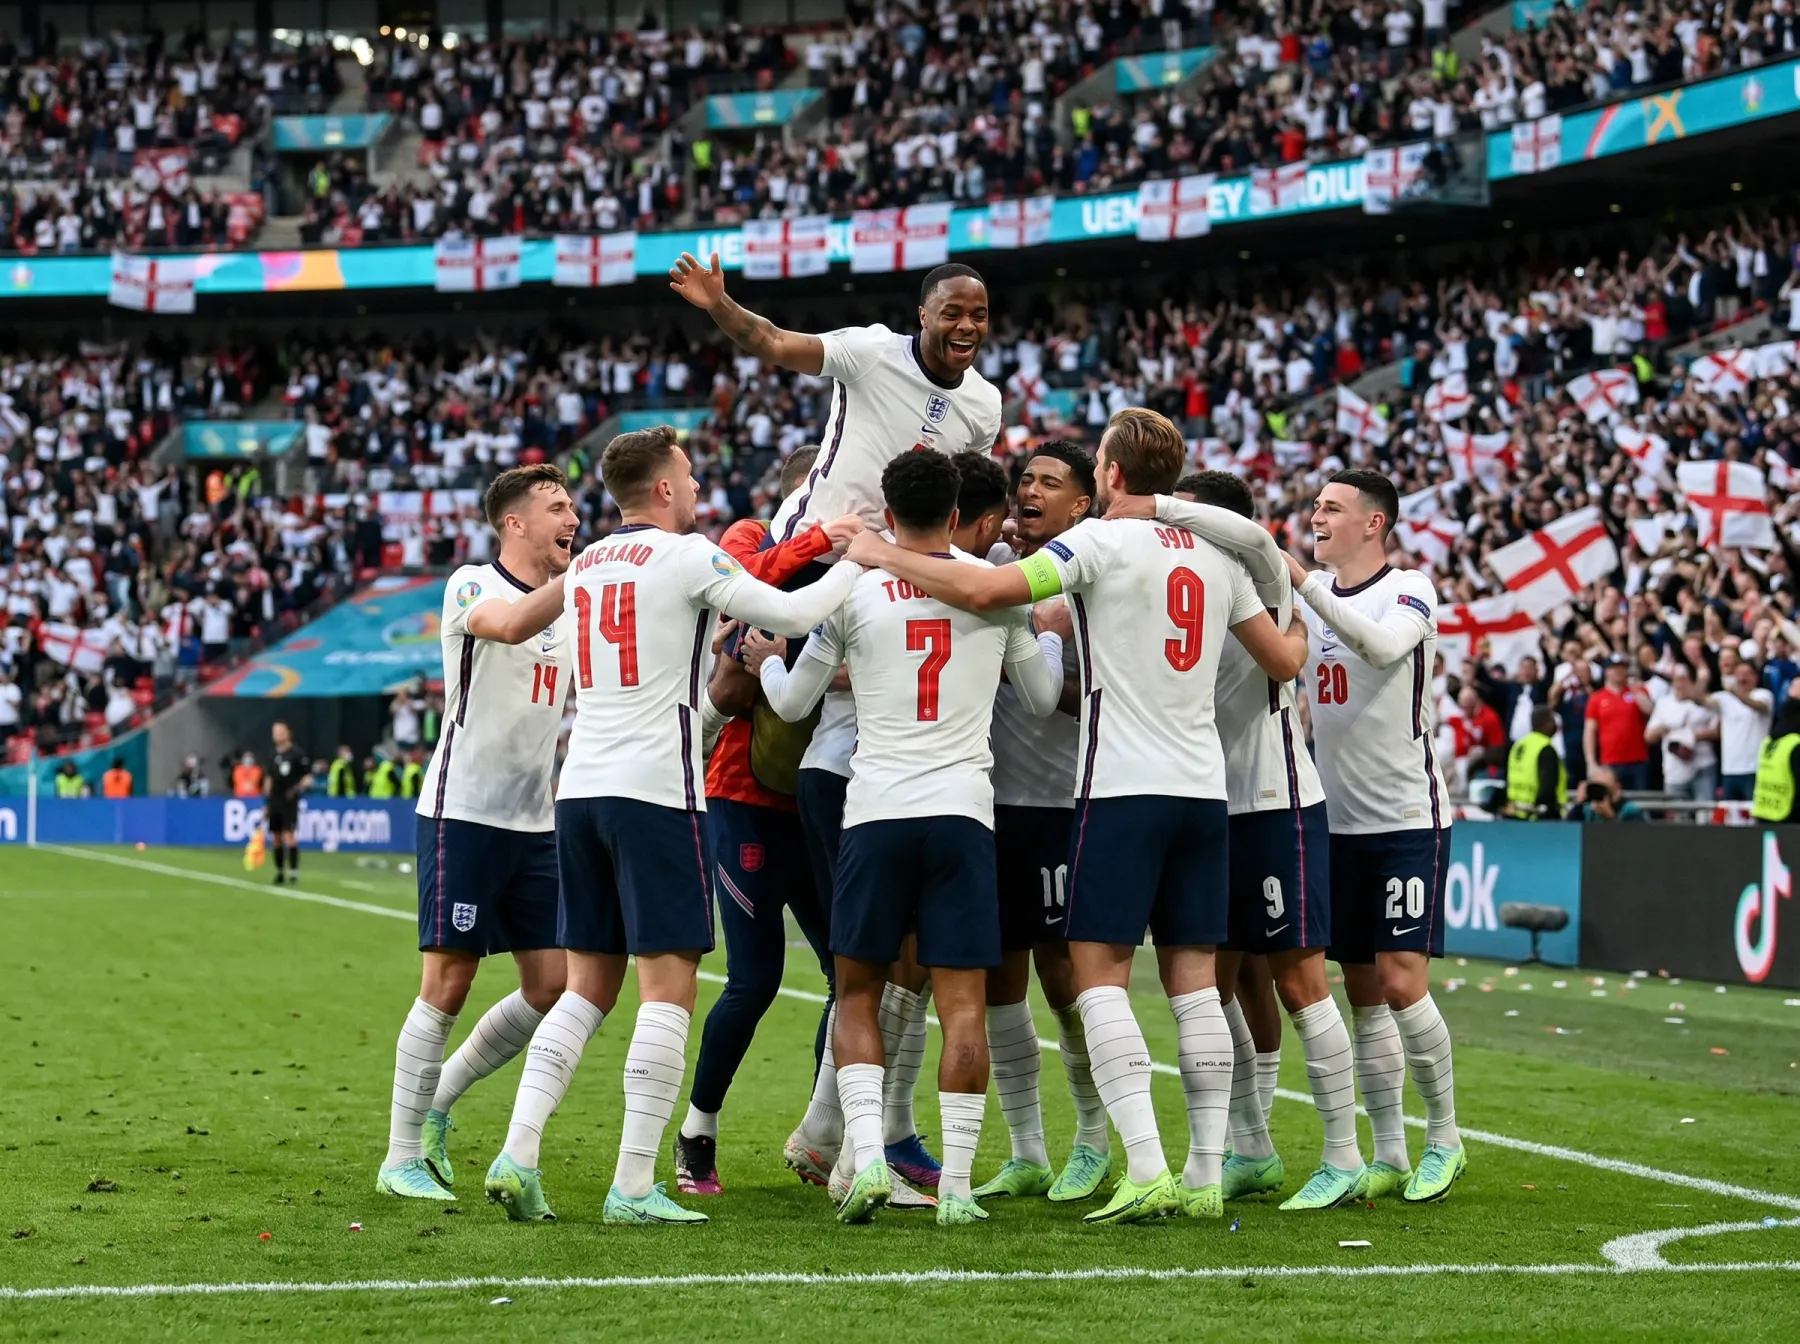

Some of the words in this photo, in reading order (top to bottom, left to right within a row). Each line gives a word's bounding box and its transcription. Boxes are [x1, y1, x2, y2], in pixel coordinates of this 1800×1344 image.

[574, 581, 640, 689] 14
[1164, 566, 1205, 672] 9
[531, 662, 558, 706] 14
[906, 619, 951, 721] 7
[1317, 663, 1348, 705] 20
[1262, 875, 1285, 919] 9
[1385, 876, 1425, 919] 20
[1196, 1060, 1232, 1068] ENGLAND
